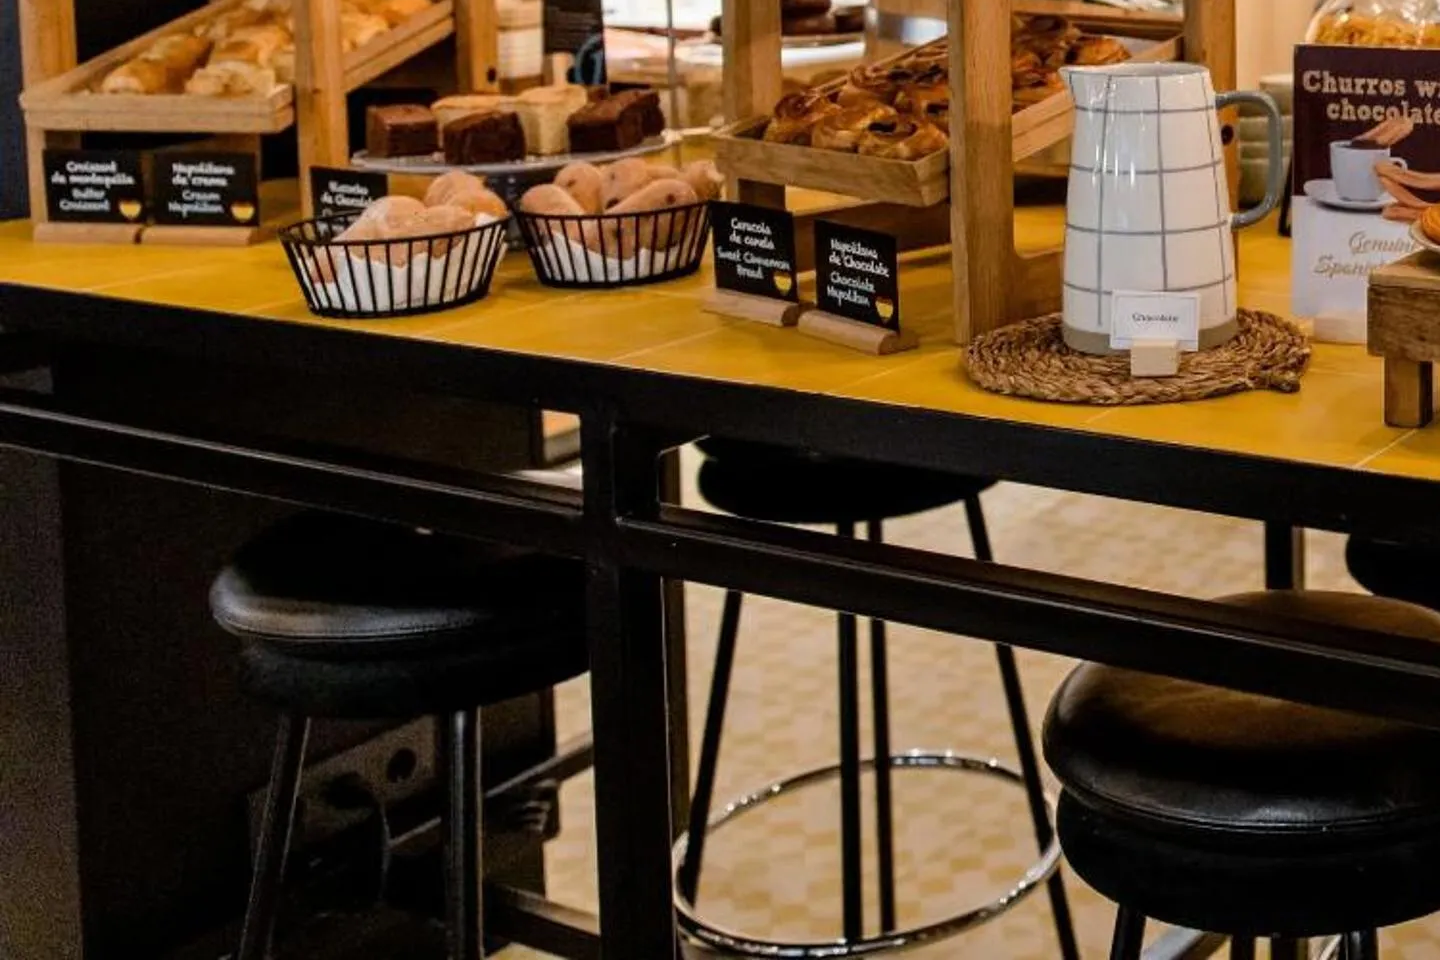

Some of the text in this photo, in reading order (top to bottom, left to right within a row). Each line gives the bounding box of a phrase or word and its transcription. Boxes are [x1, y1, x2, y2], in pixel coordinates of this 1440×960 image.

[1303, 70, 1405, 97] Churros
[729, 230, 742, 244] de
[1349, 230, 1415, 254] Genuin
[829, 251, 890, 278] de Chocolate
